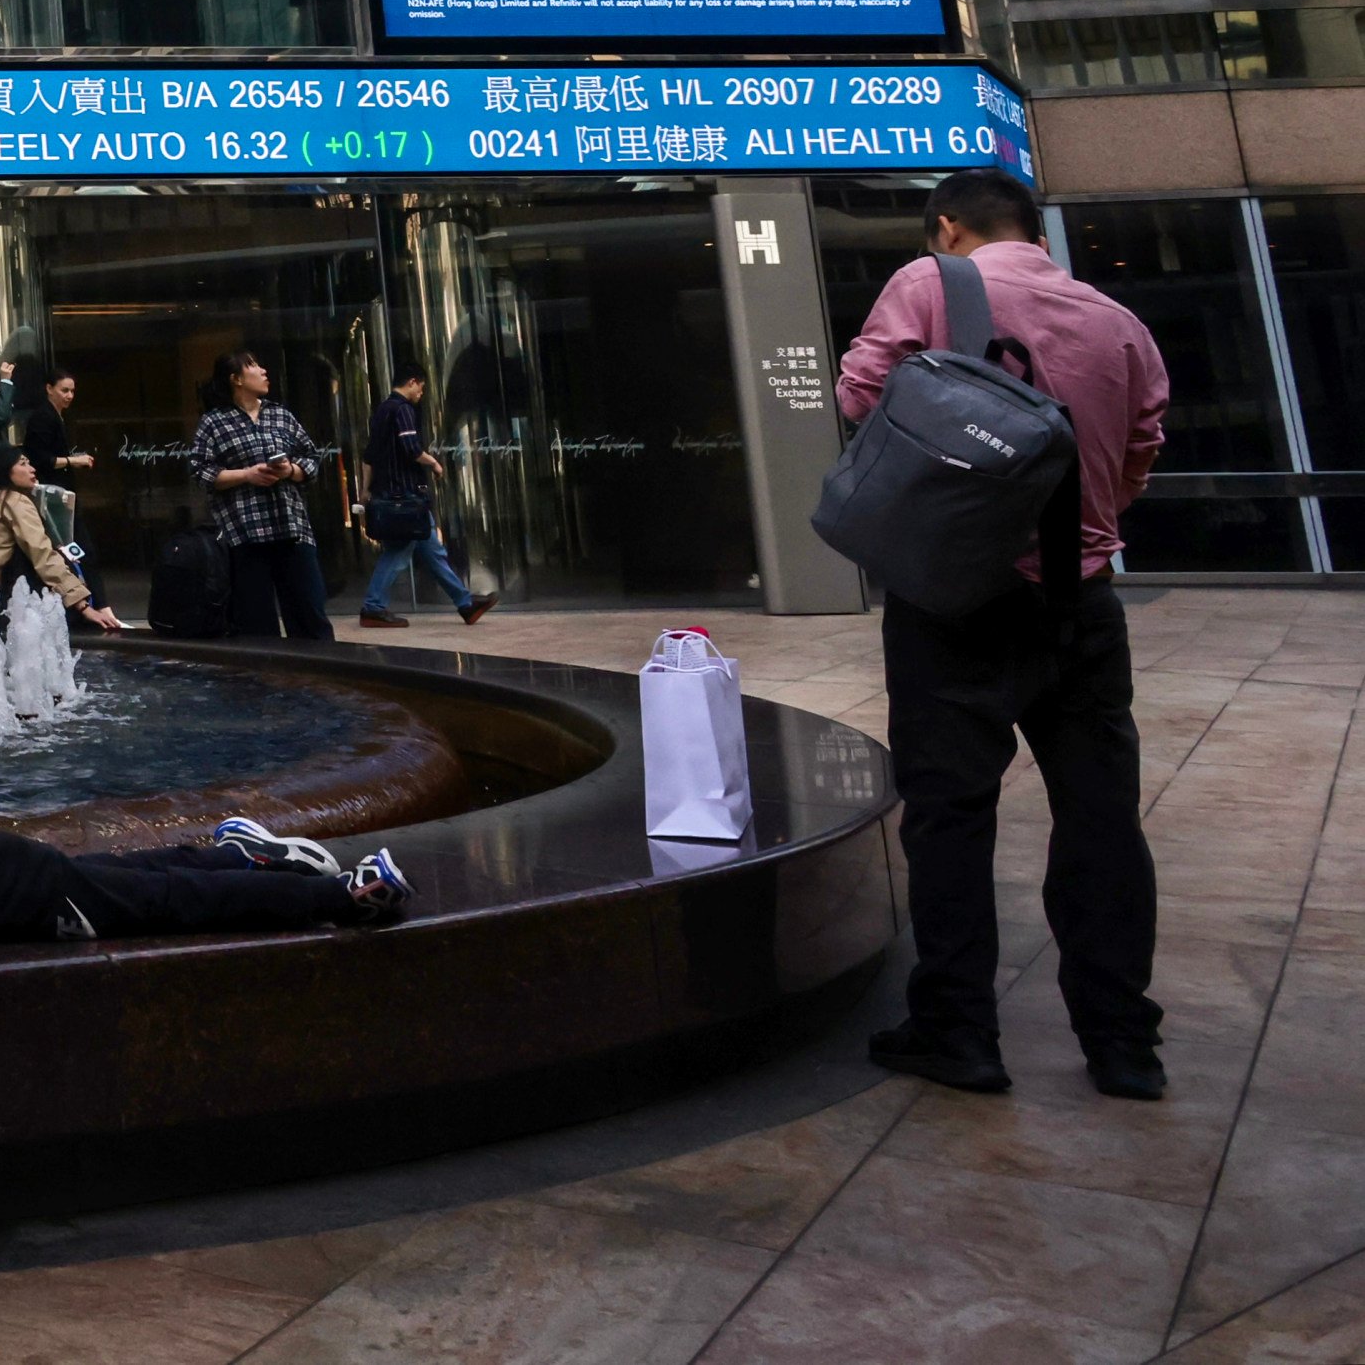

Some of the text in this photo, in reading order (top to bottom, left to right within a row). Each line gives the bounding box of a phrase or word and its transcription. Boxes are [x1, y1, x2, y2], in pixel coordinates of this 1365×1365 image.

[163, 82, 216, 108] B/A
[229, 81, 322, 108] 26545
[357, 80, 449, 107] 26546
[483, 75, 941, 113] 最高/最低 H/L 26907 26289
[92, 132, 185, 160] AUTO
[205, 131, 287, 159] 16.32
[326, 131, 407, 158] +0.17
[470, 125, 933, 163] 00241 阿里健康 ALI HEALTH
[769, 376, 820, 386] One & Two
[776, 388, 822, 399] Exchange
[790, 399, 823, 410] Square
